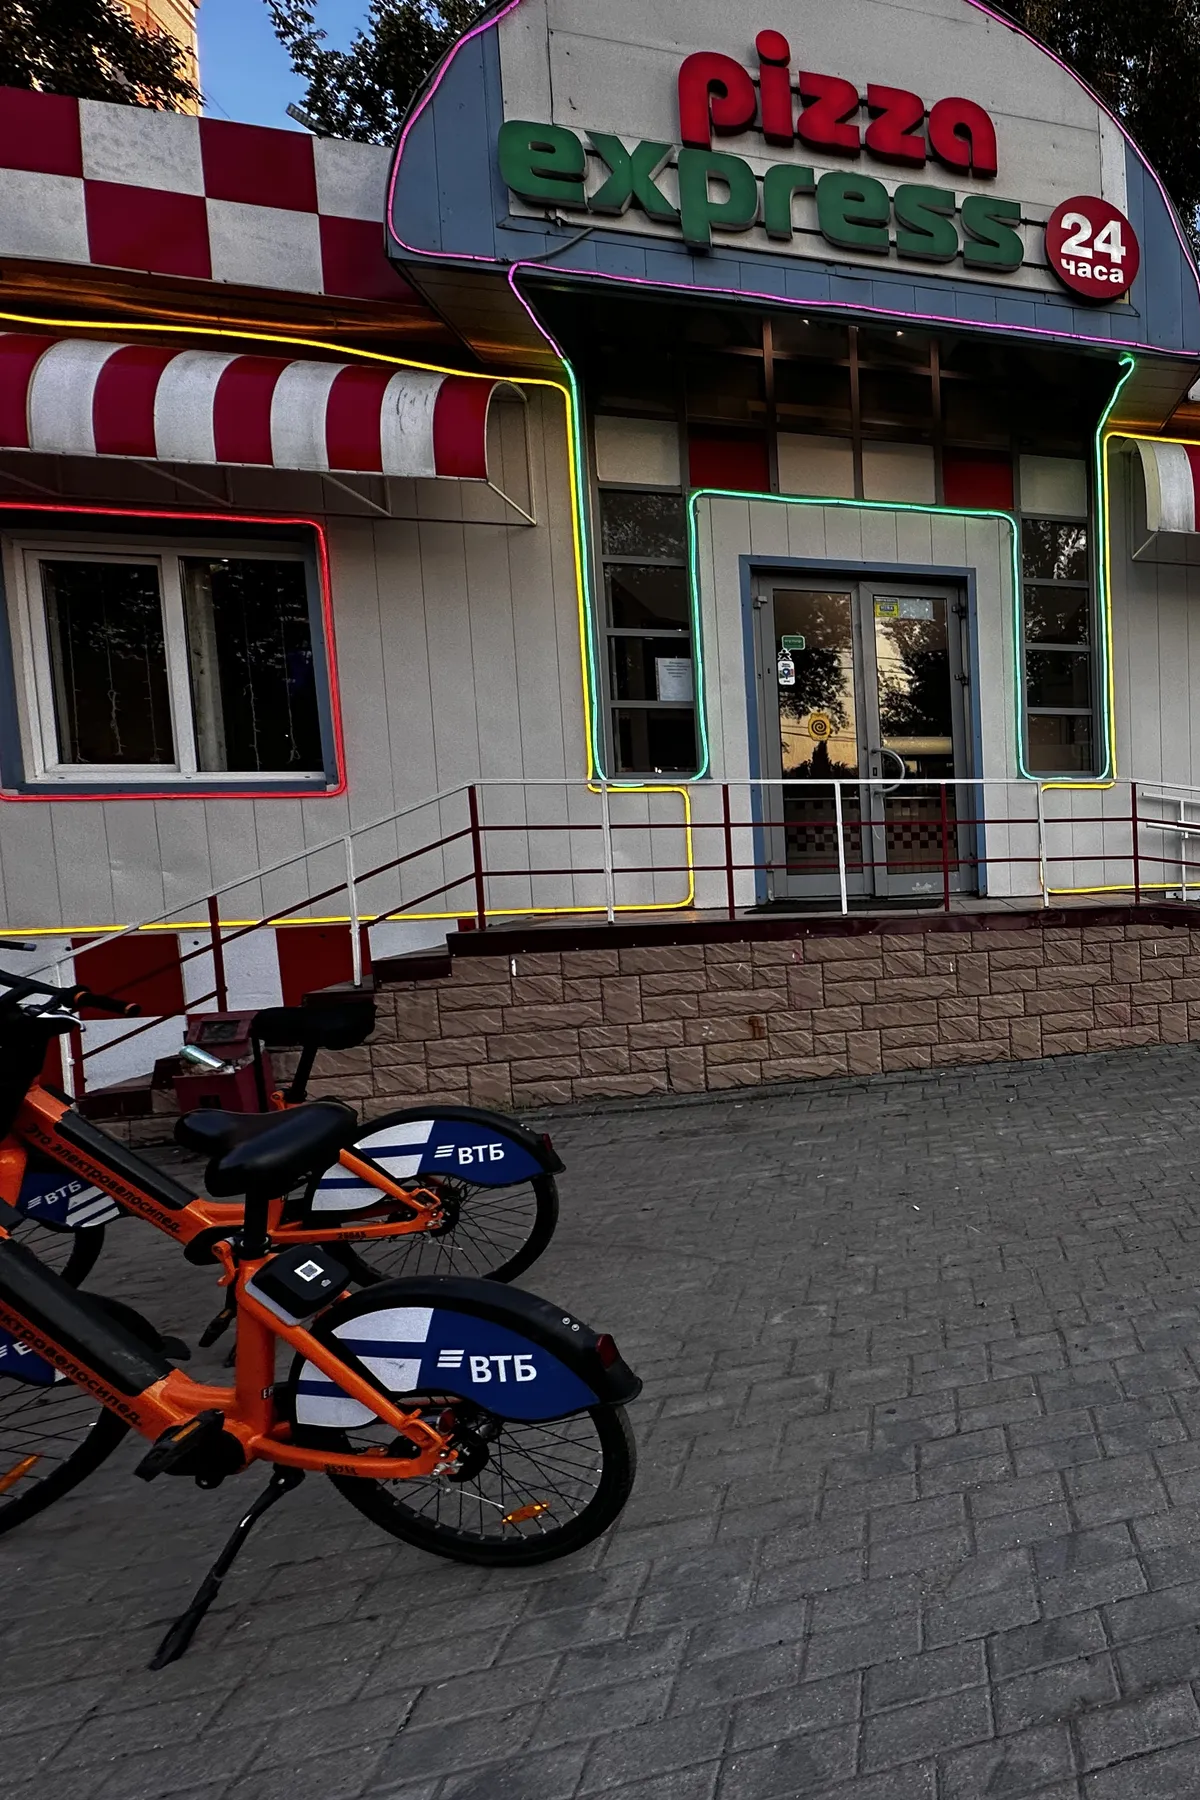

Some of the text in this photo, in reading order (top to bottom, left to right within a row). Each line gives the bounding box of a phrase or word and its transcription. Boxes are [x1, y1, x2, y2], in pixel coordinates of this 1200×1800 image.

[678, 29, 998, 178] pizza
[500, 120, 1024, 271] express
[1061, 212, 1126, 264] 24
[1061, 258, 1124, 284] часа
[458, 1143, 505, 1165] ВТБ
[44, 1180, 82, 1205] ВТБ
[469, 1354, 537, 1383] ВТБ
